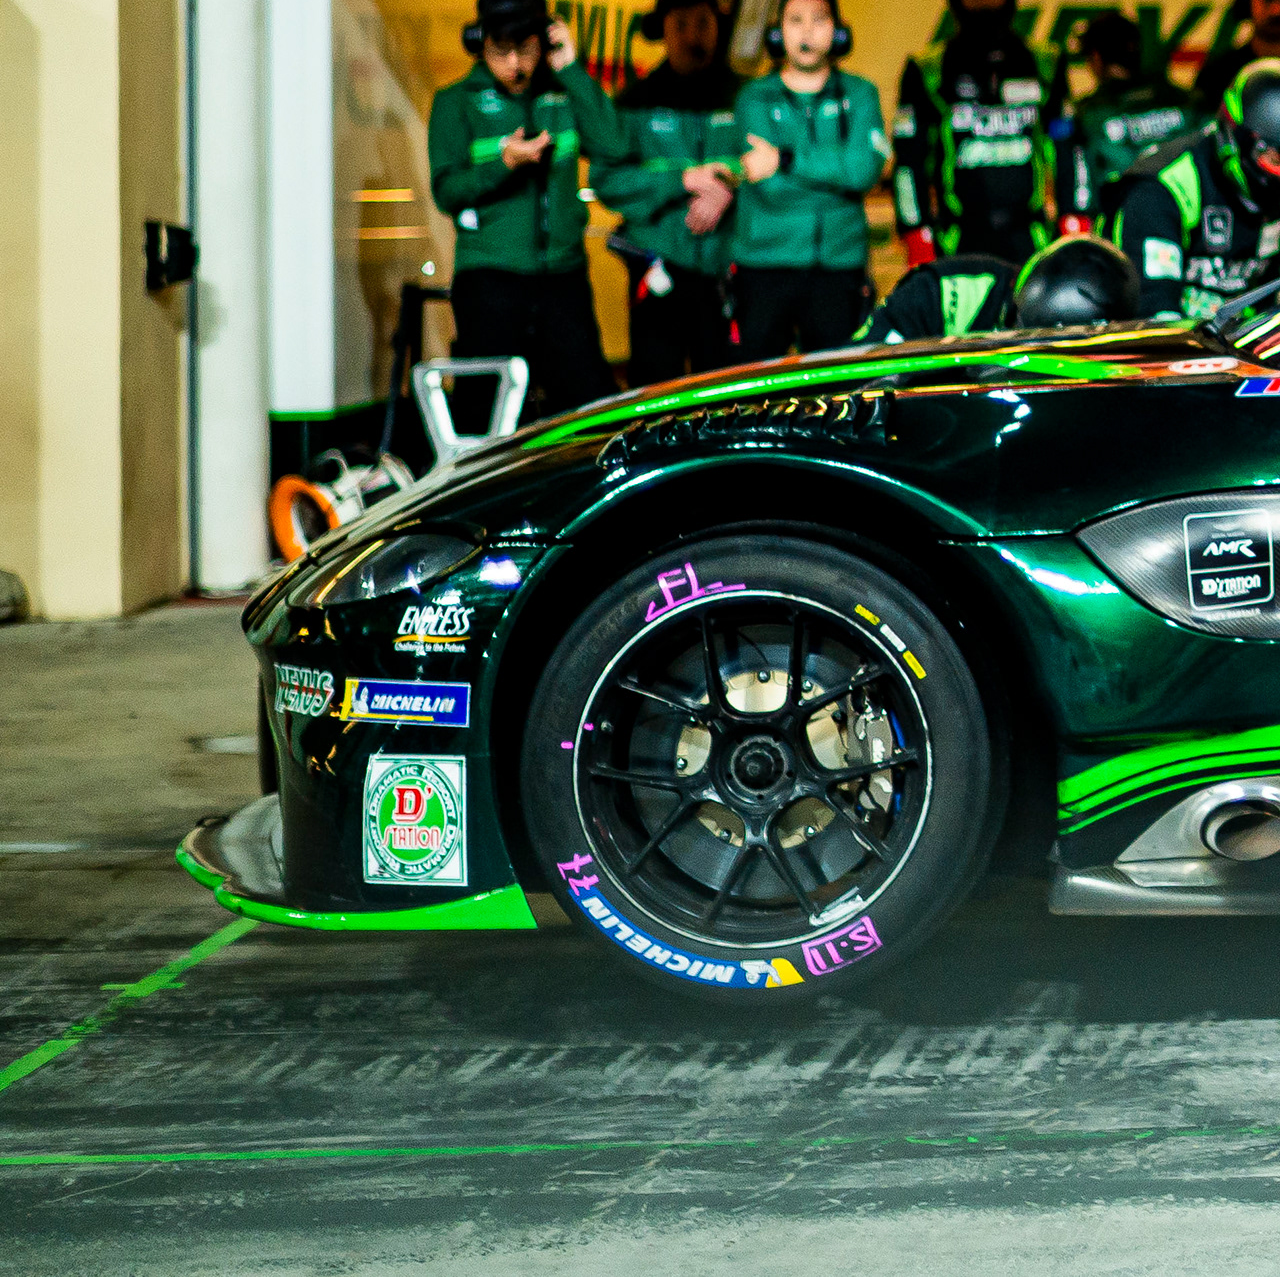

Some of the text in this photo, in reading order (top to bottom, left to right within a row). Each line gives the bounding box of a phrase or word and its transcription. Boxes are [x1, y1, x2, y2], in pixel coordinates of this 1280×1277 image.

[397, 606, 475, 636] ENDLESS
[370, 694, 456, 714] MICHELIN
[581, 896, 735, 985] MICHELIN
